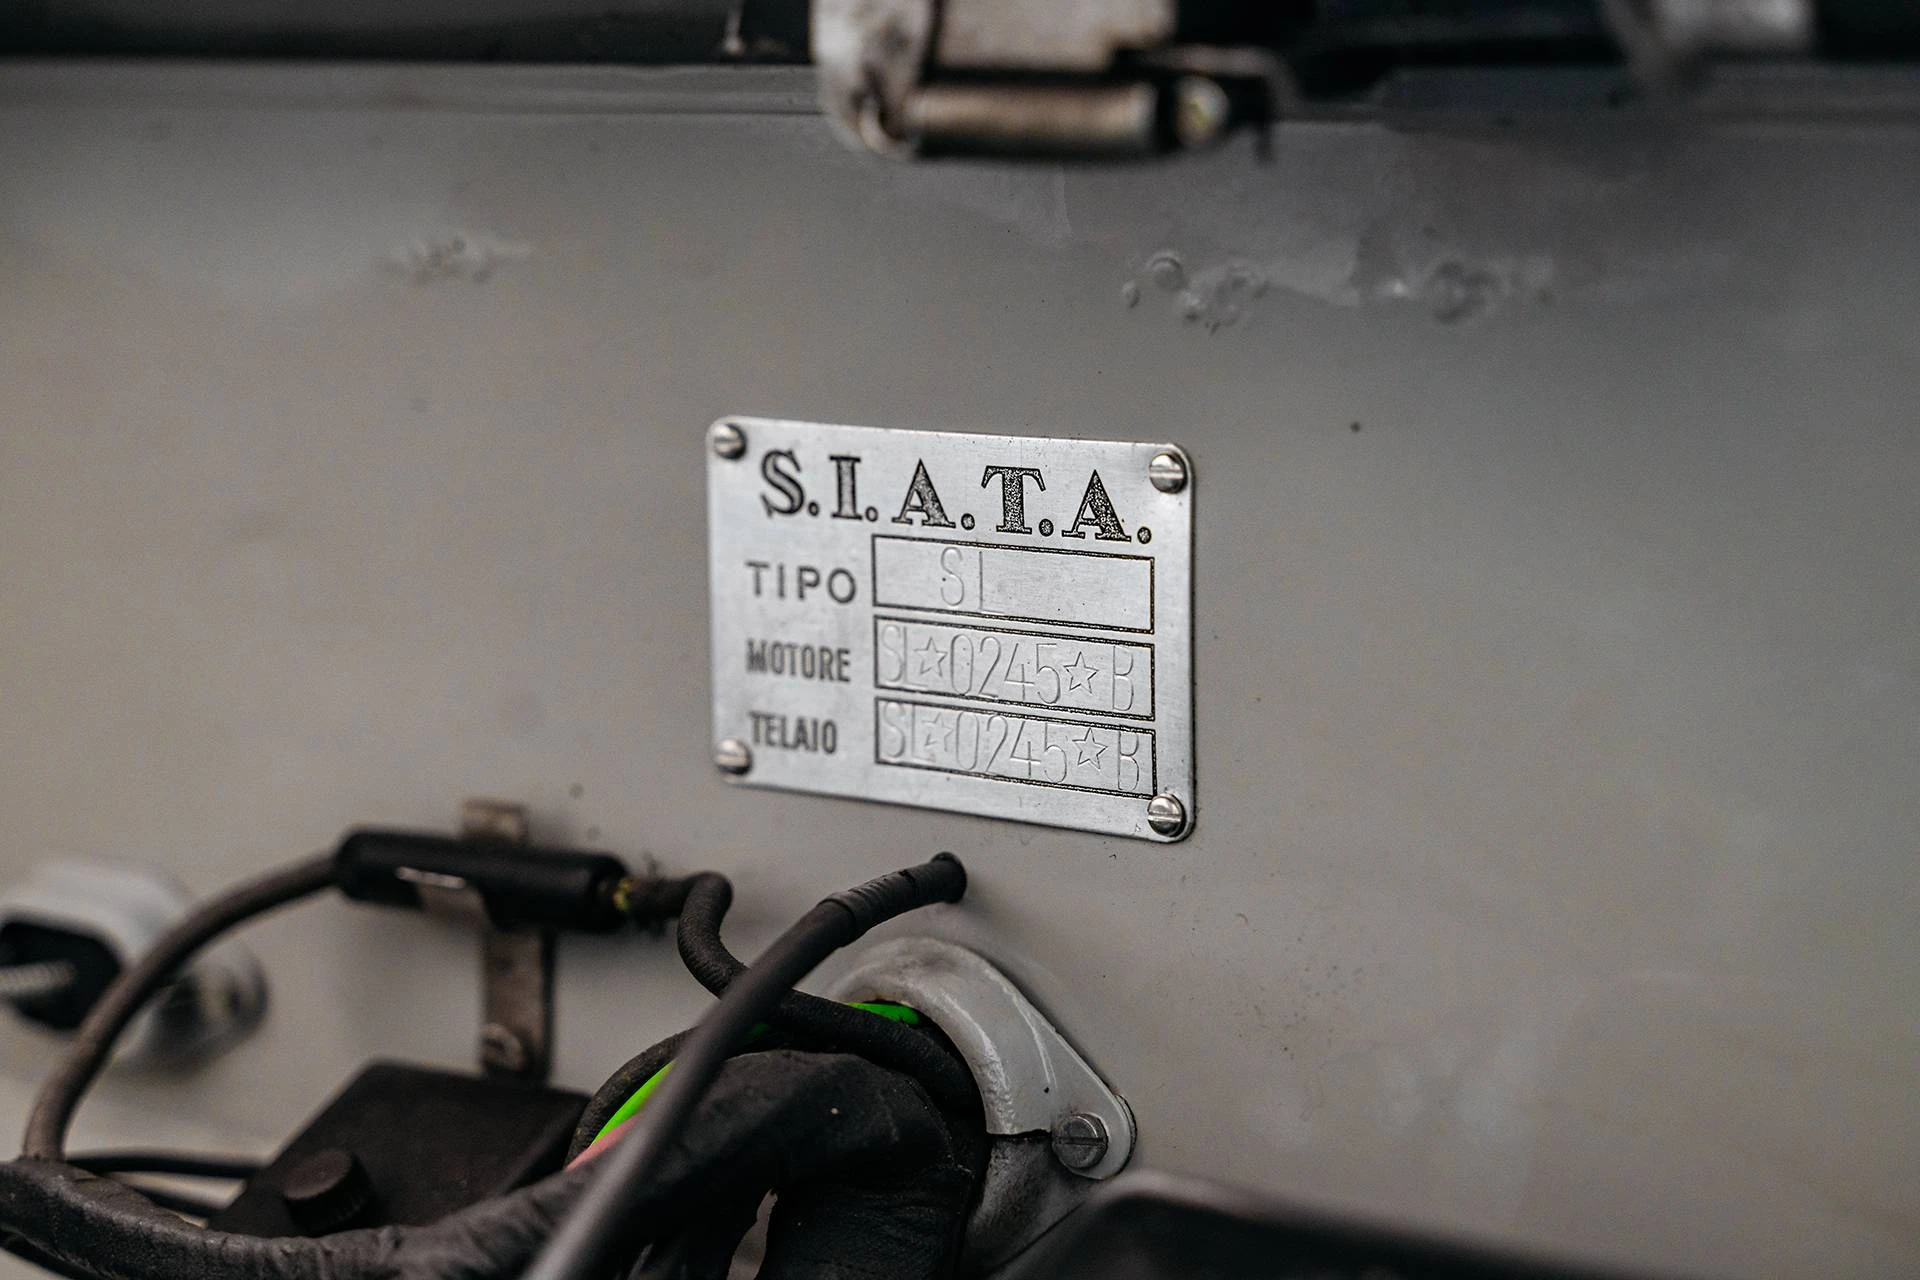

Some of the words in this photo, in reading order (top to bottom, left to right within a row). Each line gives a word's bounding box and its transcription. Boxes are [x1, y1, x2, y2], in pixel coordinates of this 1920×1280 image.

[760, 448, 1153, 546] S.I.A.T.A.
[746, 560, 857, 604] TIPO
[940, 546, 1006, 615] SL
[747, 637, 852, 682] MOTORE
[748, 710, 838, 755] TELAIO
